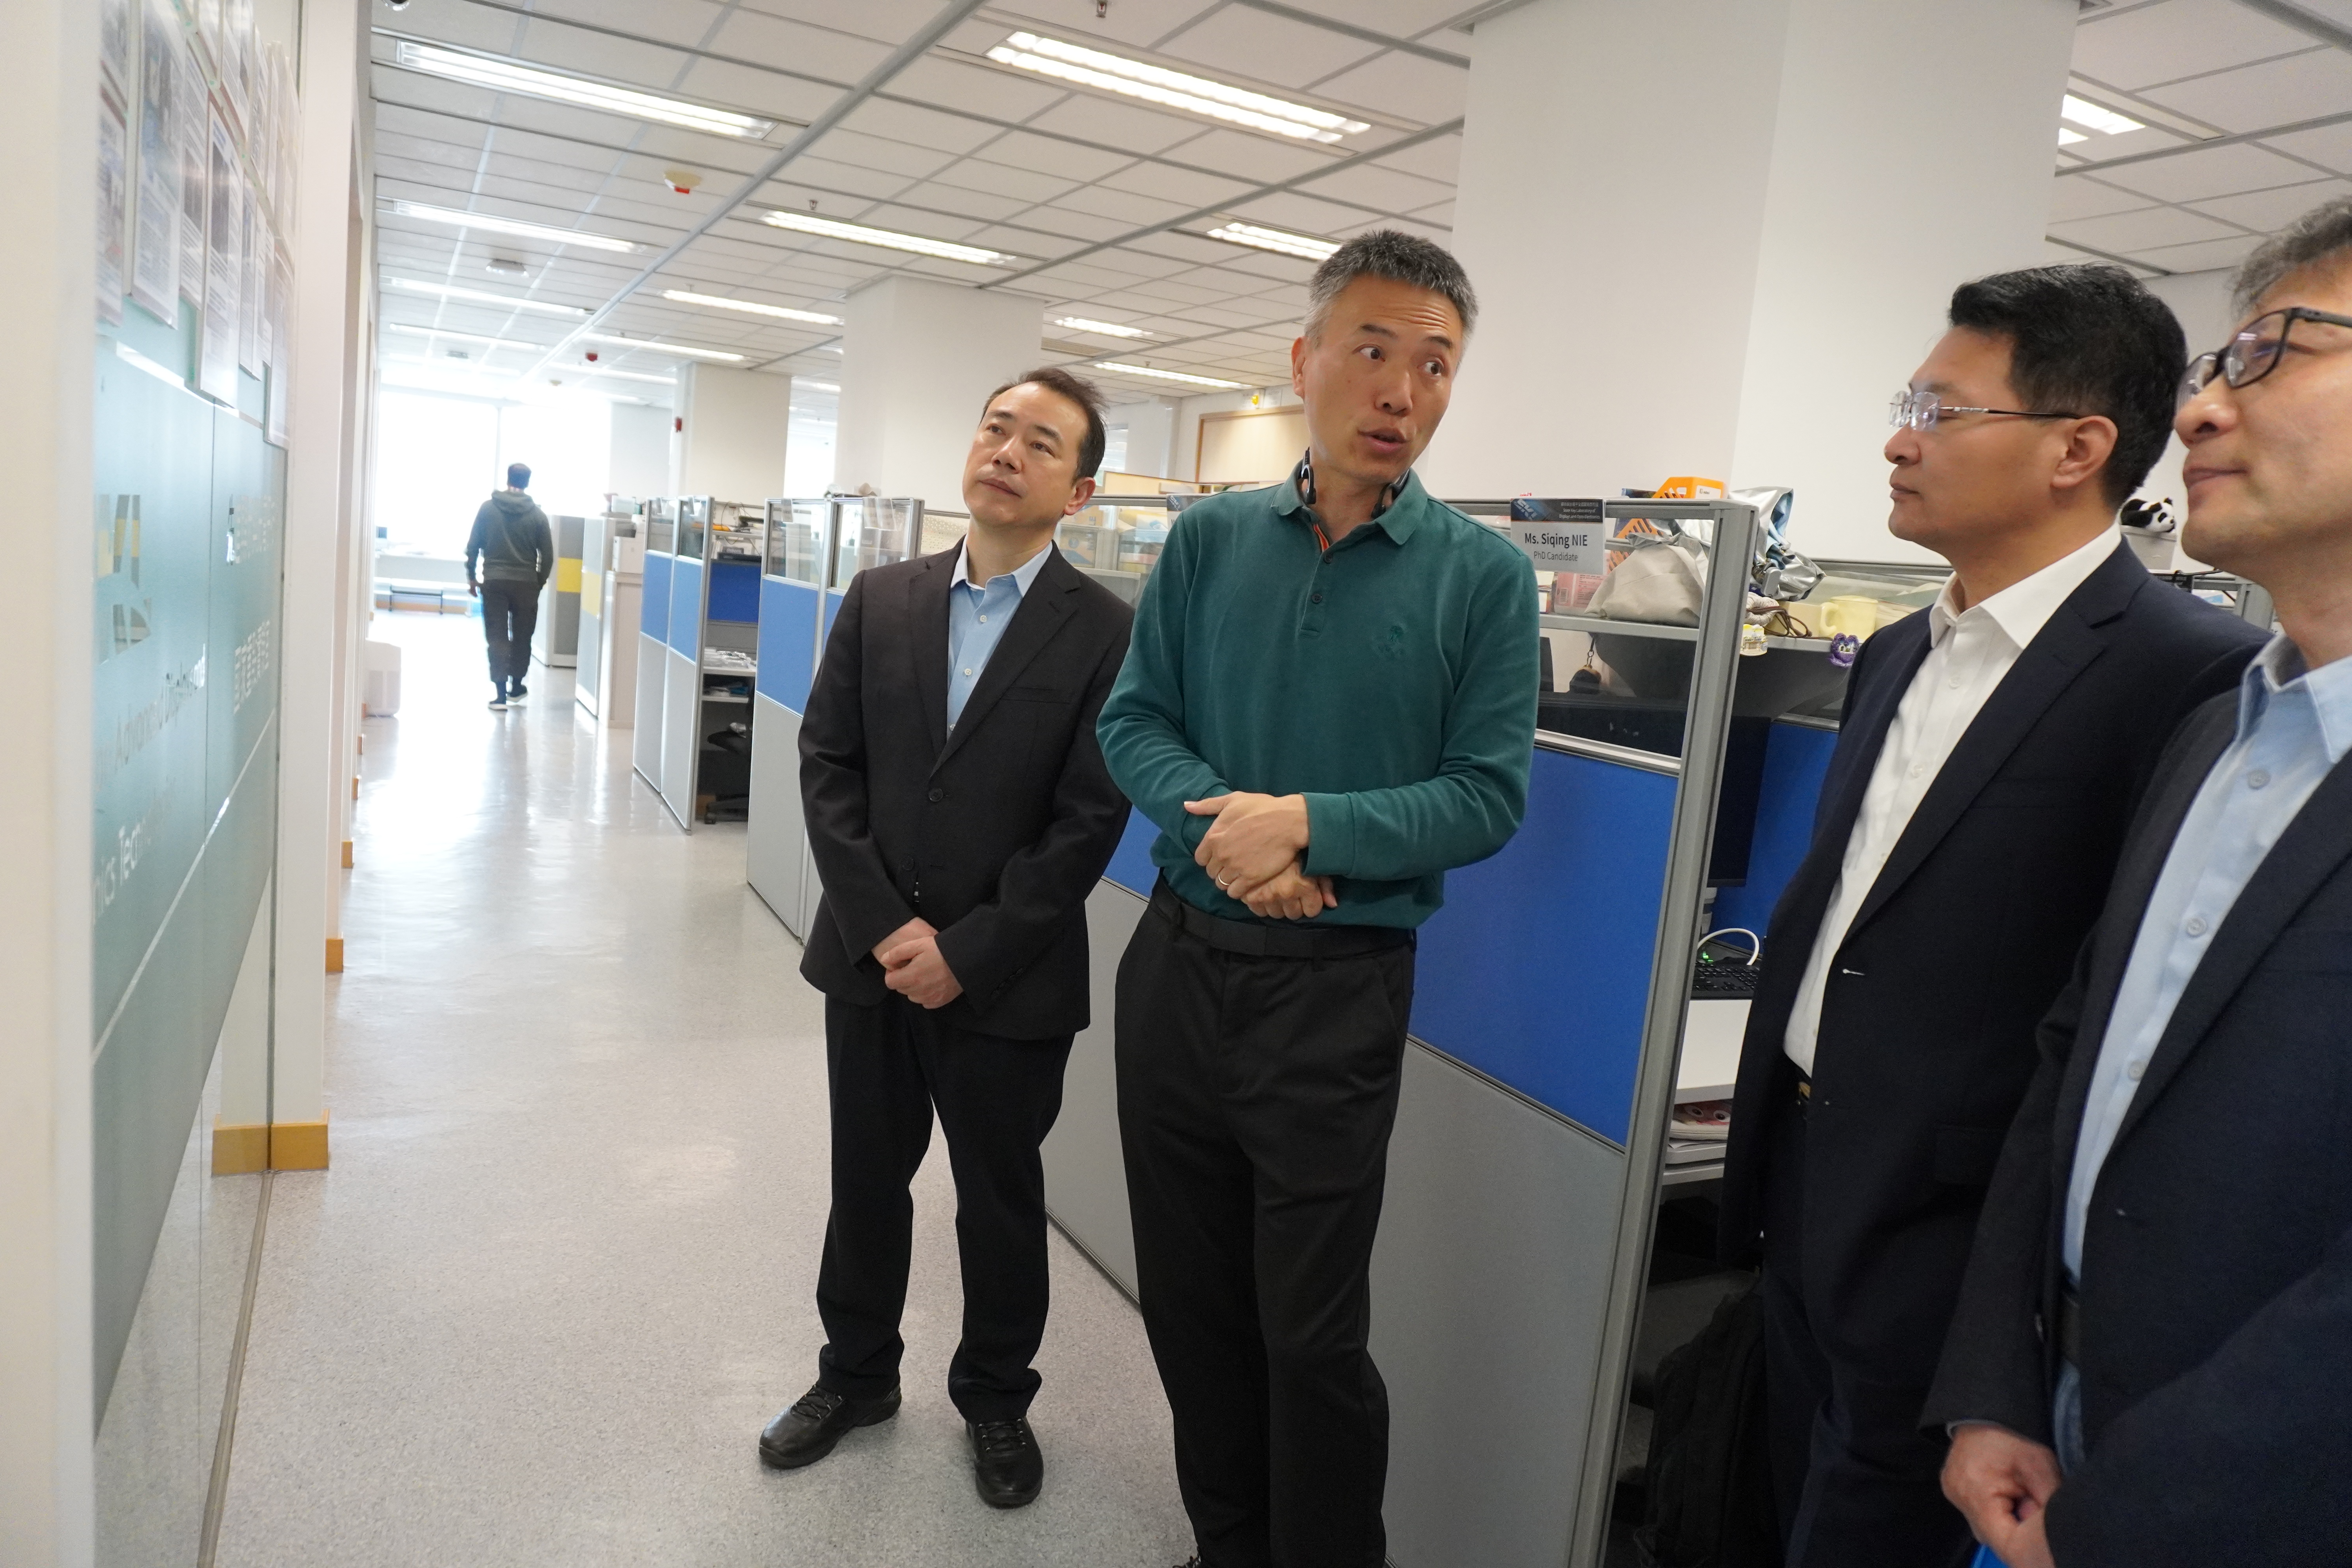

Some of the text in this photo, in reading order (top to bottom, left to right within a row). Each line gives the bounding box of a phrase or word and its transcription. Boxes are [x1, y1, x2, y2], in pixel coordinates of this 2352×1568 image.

[1524, 533, 1588, 548] Ms. Siqing NIE
[1534, 551, 1578, 561] PhD Candidate
